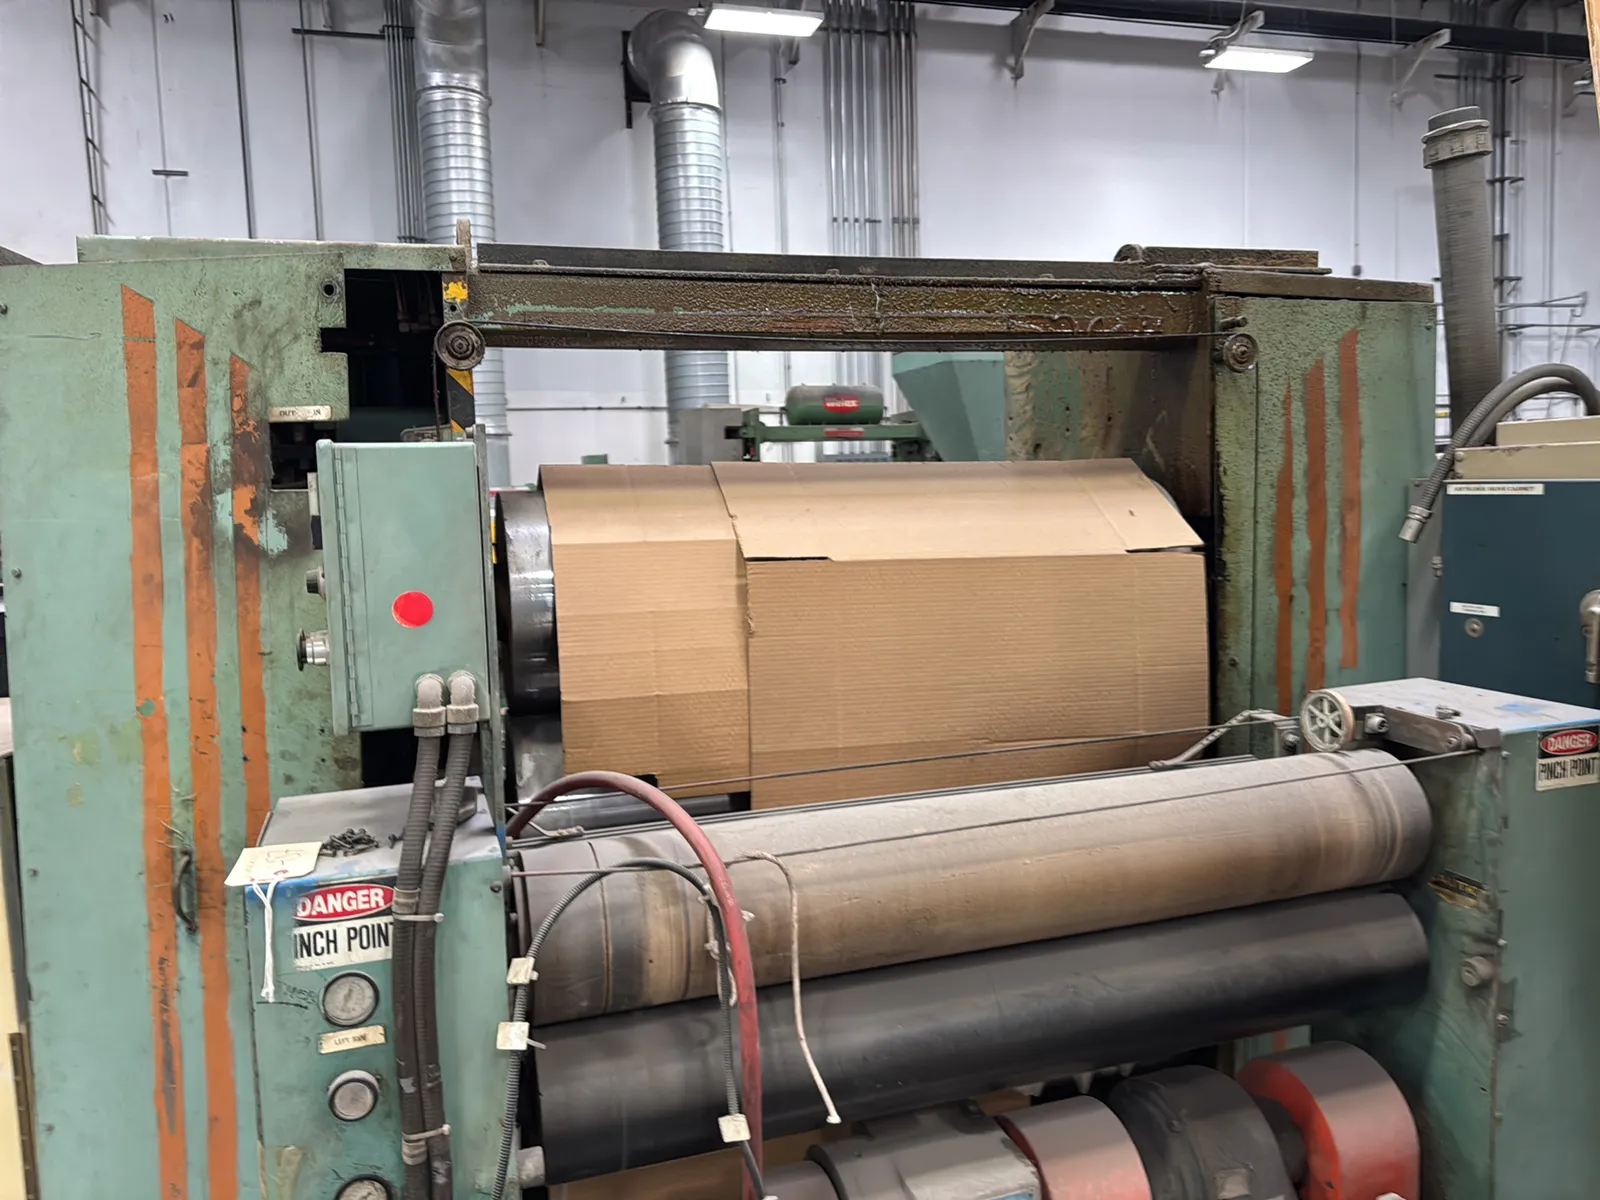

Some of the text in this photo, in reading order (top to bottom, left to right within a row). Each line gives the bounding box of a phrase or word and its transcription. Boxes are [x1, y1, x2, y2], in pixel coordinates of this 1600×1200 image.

[1547, 733, 1593, 751] DANGER
[1538, 757, 1596, 781] PINCH POINT
[296, 887, 385, 917] DANGER
[294, 928, 338, 960] INCH
